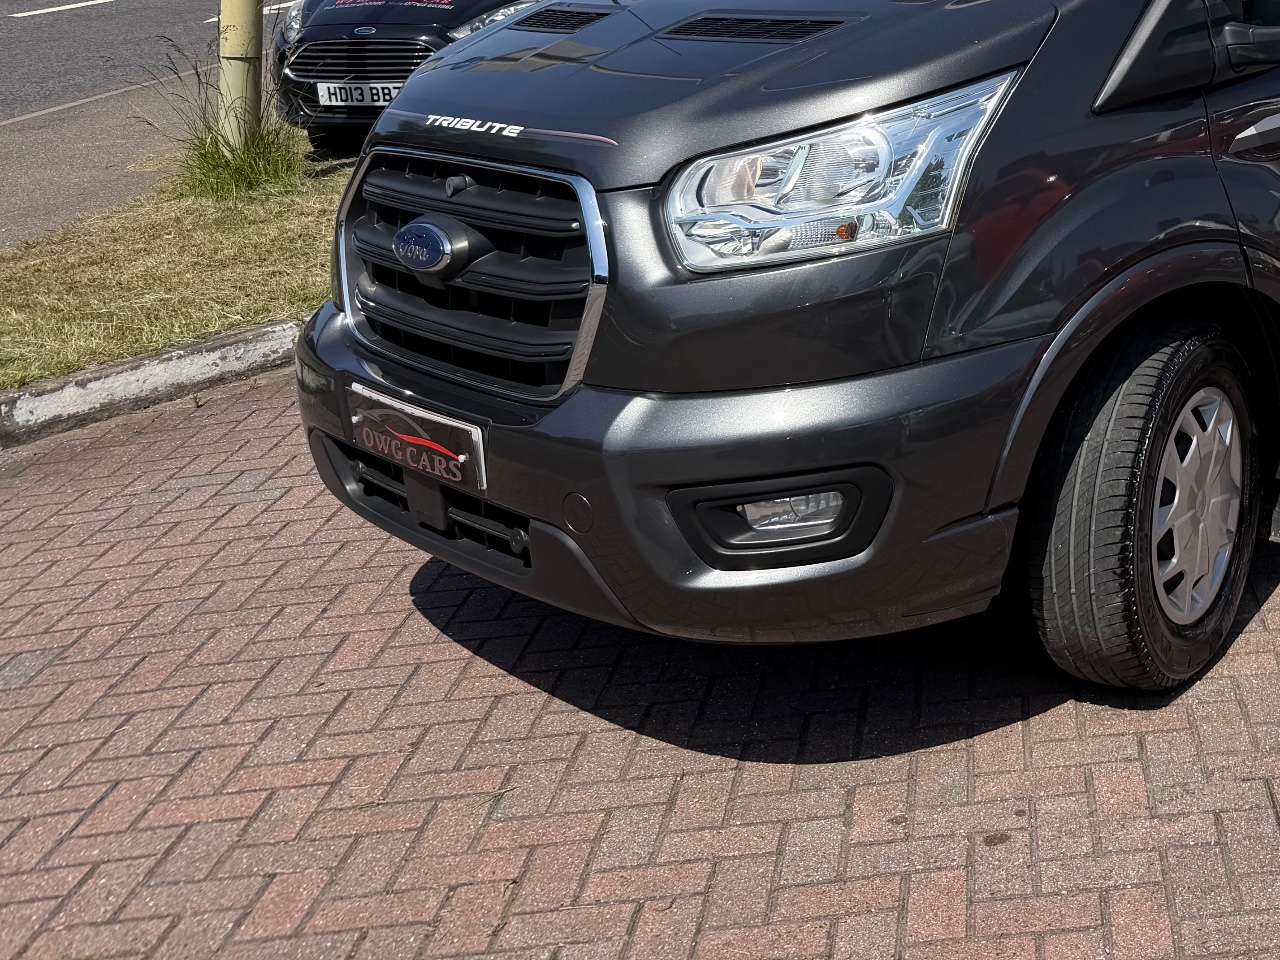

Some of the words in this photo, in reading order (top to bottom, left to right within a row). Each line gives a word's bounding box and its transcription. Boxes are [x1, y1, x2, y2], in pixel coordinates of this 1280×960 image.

[328, 86, 364, 103] HD13
[425, 114, 524, 137] TRIBUTE
[363, 427, 403, 459] OWG
[406, 447, 462, 481] CARS
